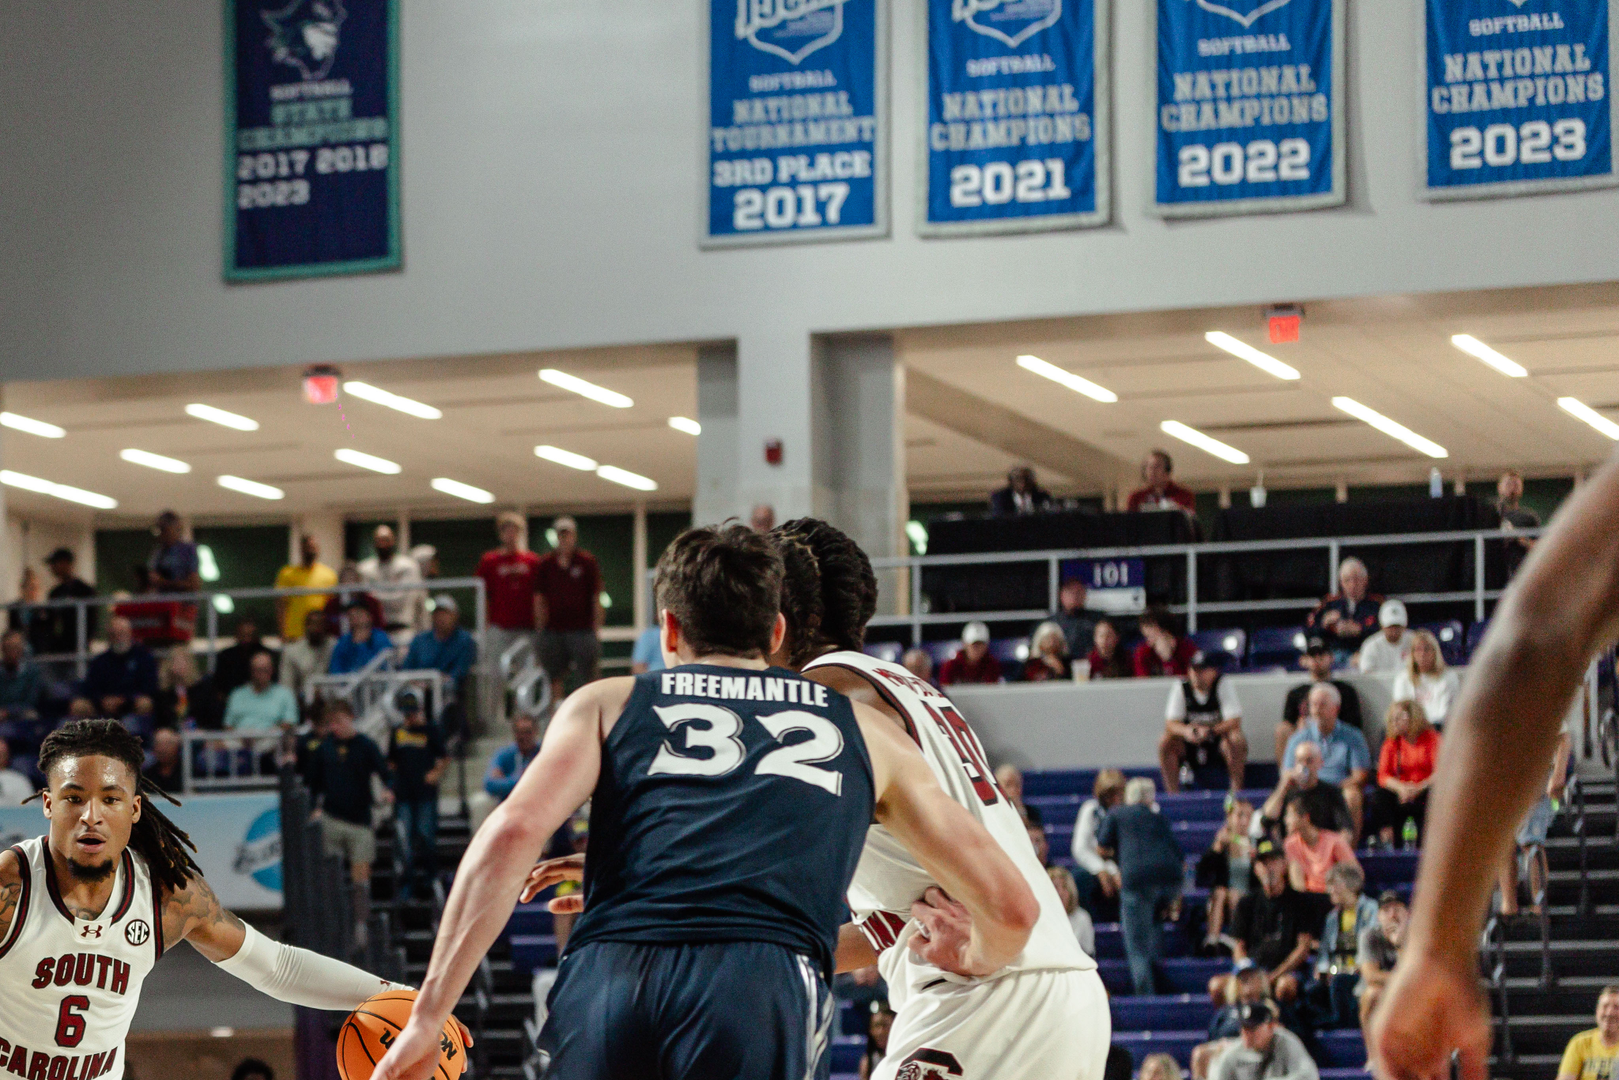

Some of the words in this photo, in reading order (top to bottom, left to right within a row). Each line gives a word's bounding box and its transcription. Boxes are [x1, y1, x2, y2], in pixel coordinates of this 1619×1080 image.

[1469, 12, 1565, 37] SOFTBALL
[1198, 33, 1291, 57] SOFTBALL
[1444, 43, 1591, 83] NATIONAL
[749, 70, 837, 92] SOFTBALL
[967, 53, 1056, 78] SOFTBALL
[1173, 64, 1316, 100] NATIONAL
[733, 90, 853, 125] NATIONAL
[942, 83, 1080, 121] NATIONAL
[1431, 72, 1605, 114] CHAMPIONS
[930, 113, 1092, 151] CHAMPIONS
[1161, 94, 1329, 132] CHAMPIONS
[712, 115, 876, 153] TOURNAMENT
[1449, 118, 1587, 170] 2023
[713, 157, 773, 187] 3RD
[777, 150, 872, 184] PLACE
[1178, 138, 1311, 188] 2022
[950, 159, 1071, 207] 2021
[733, 181, 851, 230] 2017
[1093, 562, 1128, 588] 101
[661, 672, 829, 709] FREEMANTLE
[647, 702, 845, 797] 32
[126, 919, 150, 946] SEC
[31, 953, 131, 996] SOUTH
[54, 994, 91, 1048] 6
